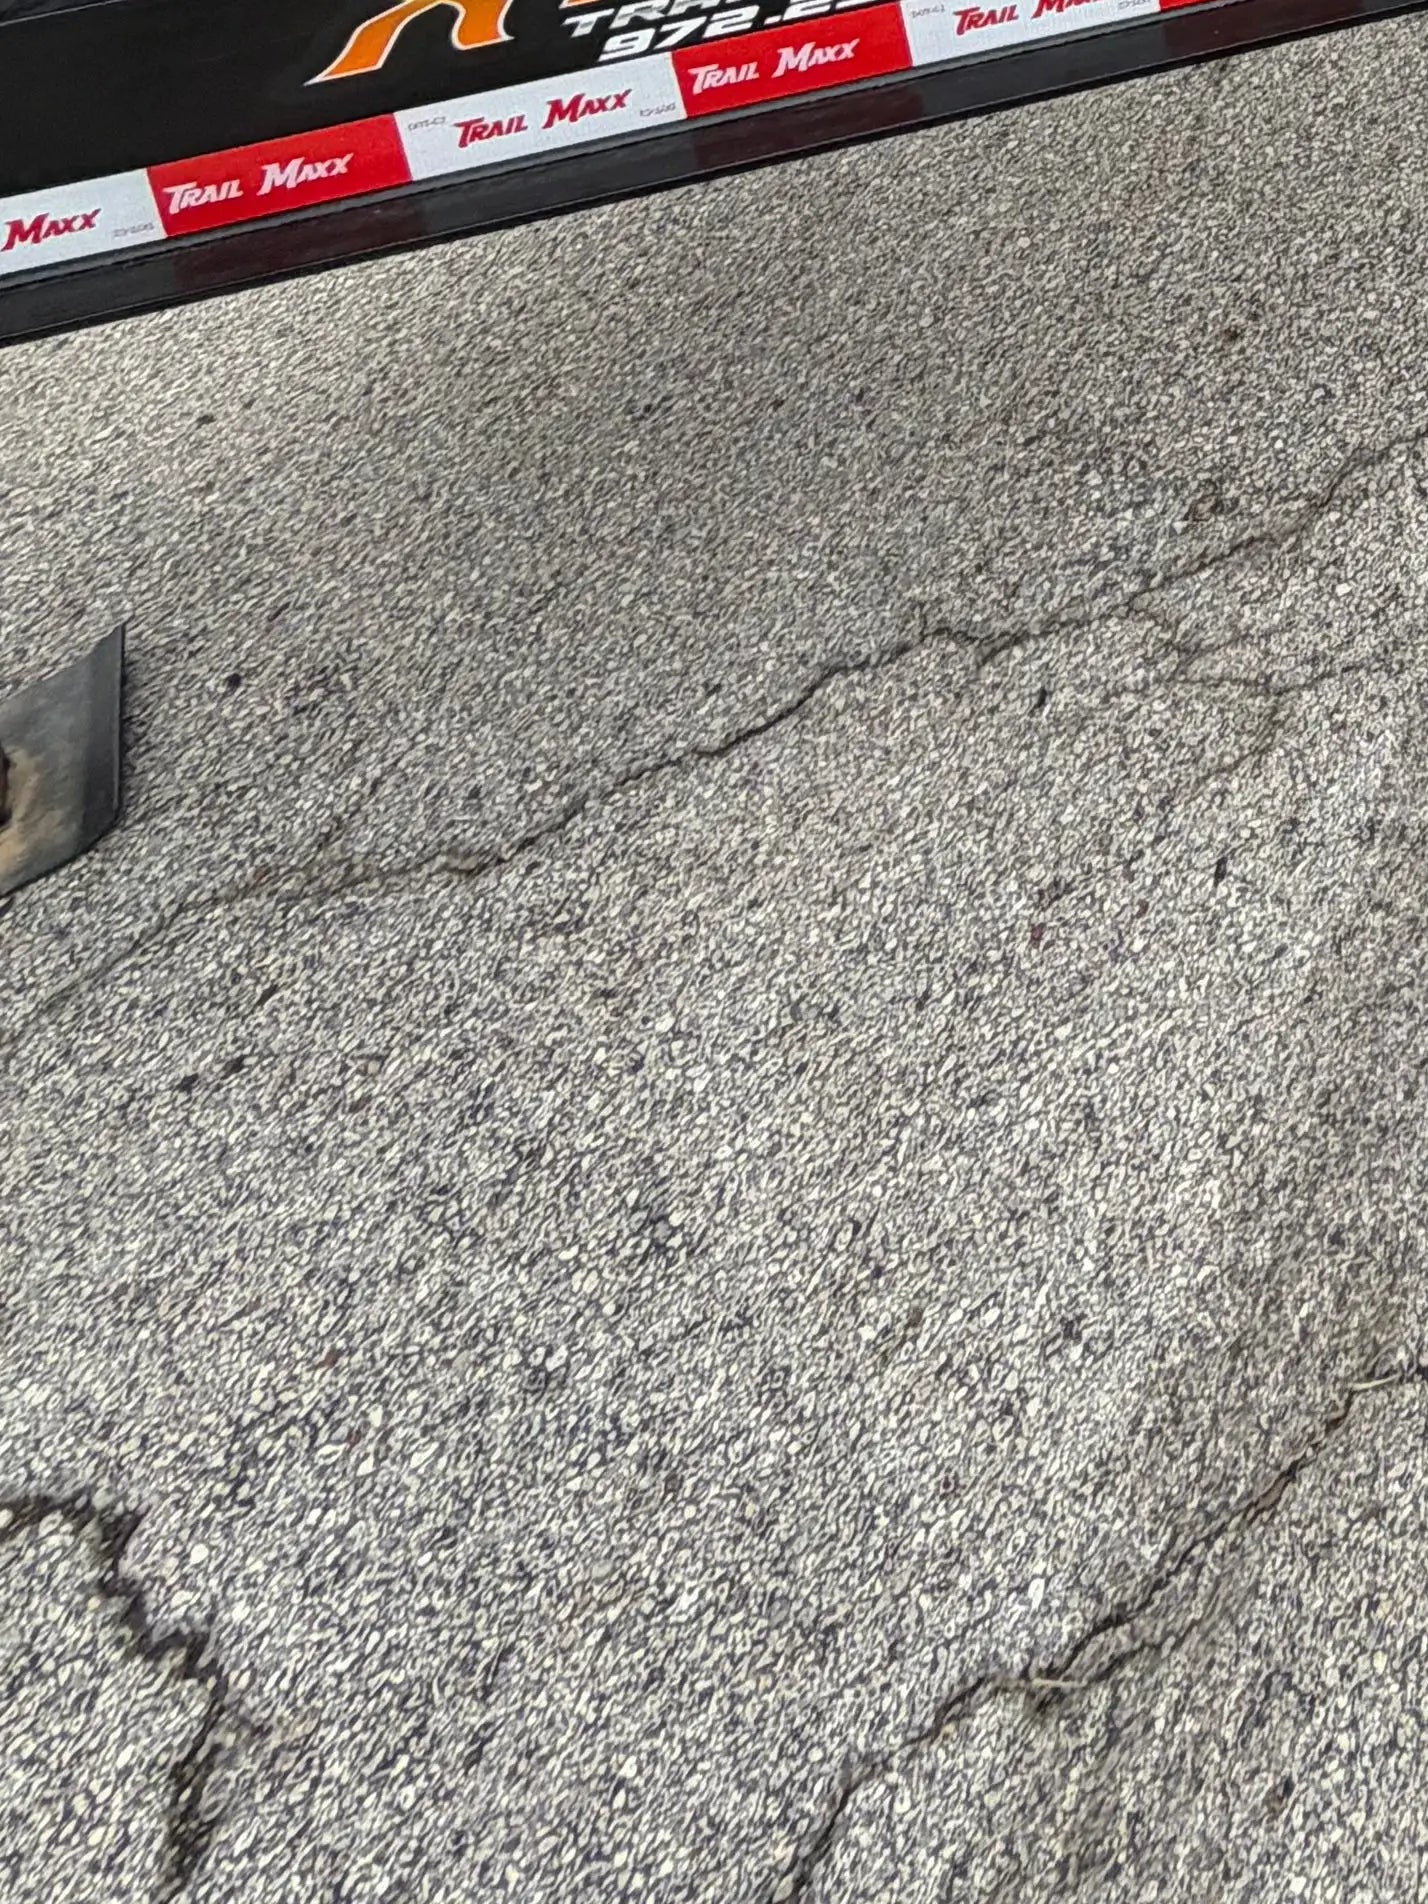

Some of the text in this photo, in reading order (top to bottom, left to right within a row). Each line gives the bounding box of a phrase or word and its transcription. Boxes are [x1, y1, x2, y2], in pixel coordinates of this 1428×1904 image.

[953, 4, 1019, 36] TRAIL
[687, 38, 861, 95] TRAIL MAXX
[453, 114, 529, 149] TRAIL
[541, 88, 633, 130] MAXX
[162, 153, 353, 215] TRAIL MAXX
[0, 207, 102, 252] MAXX
